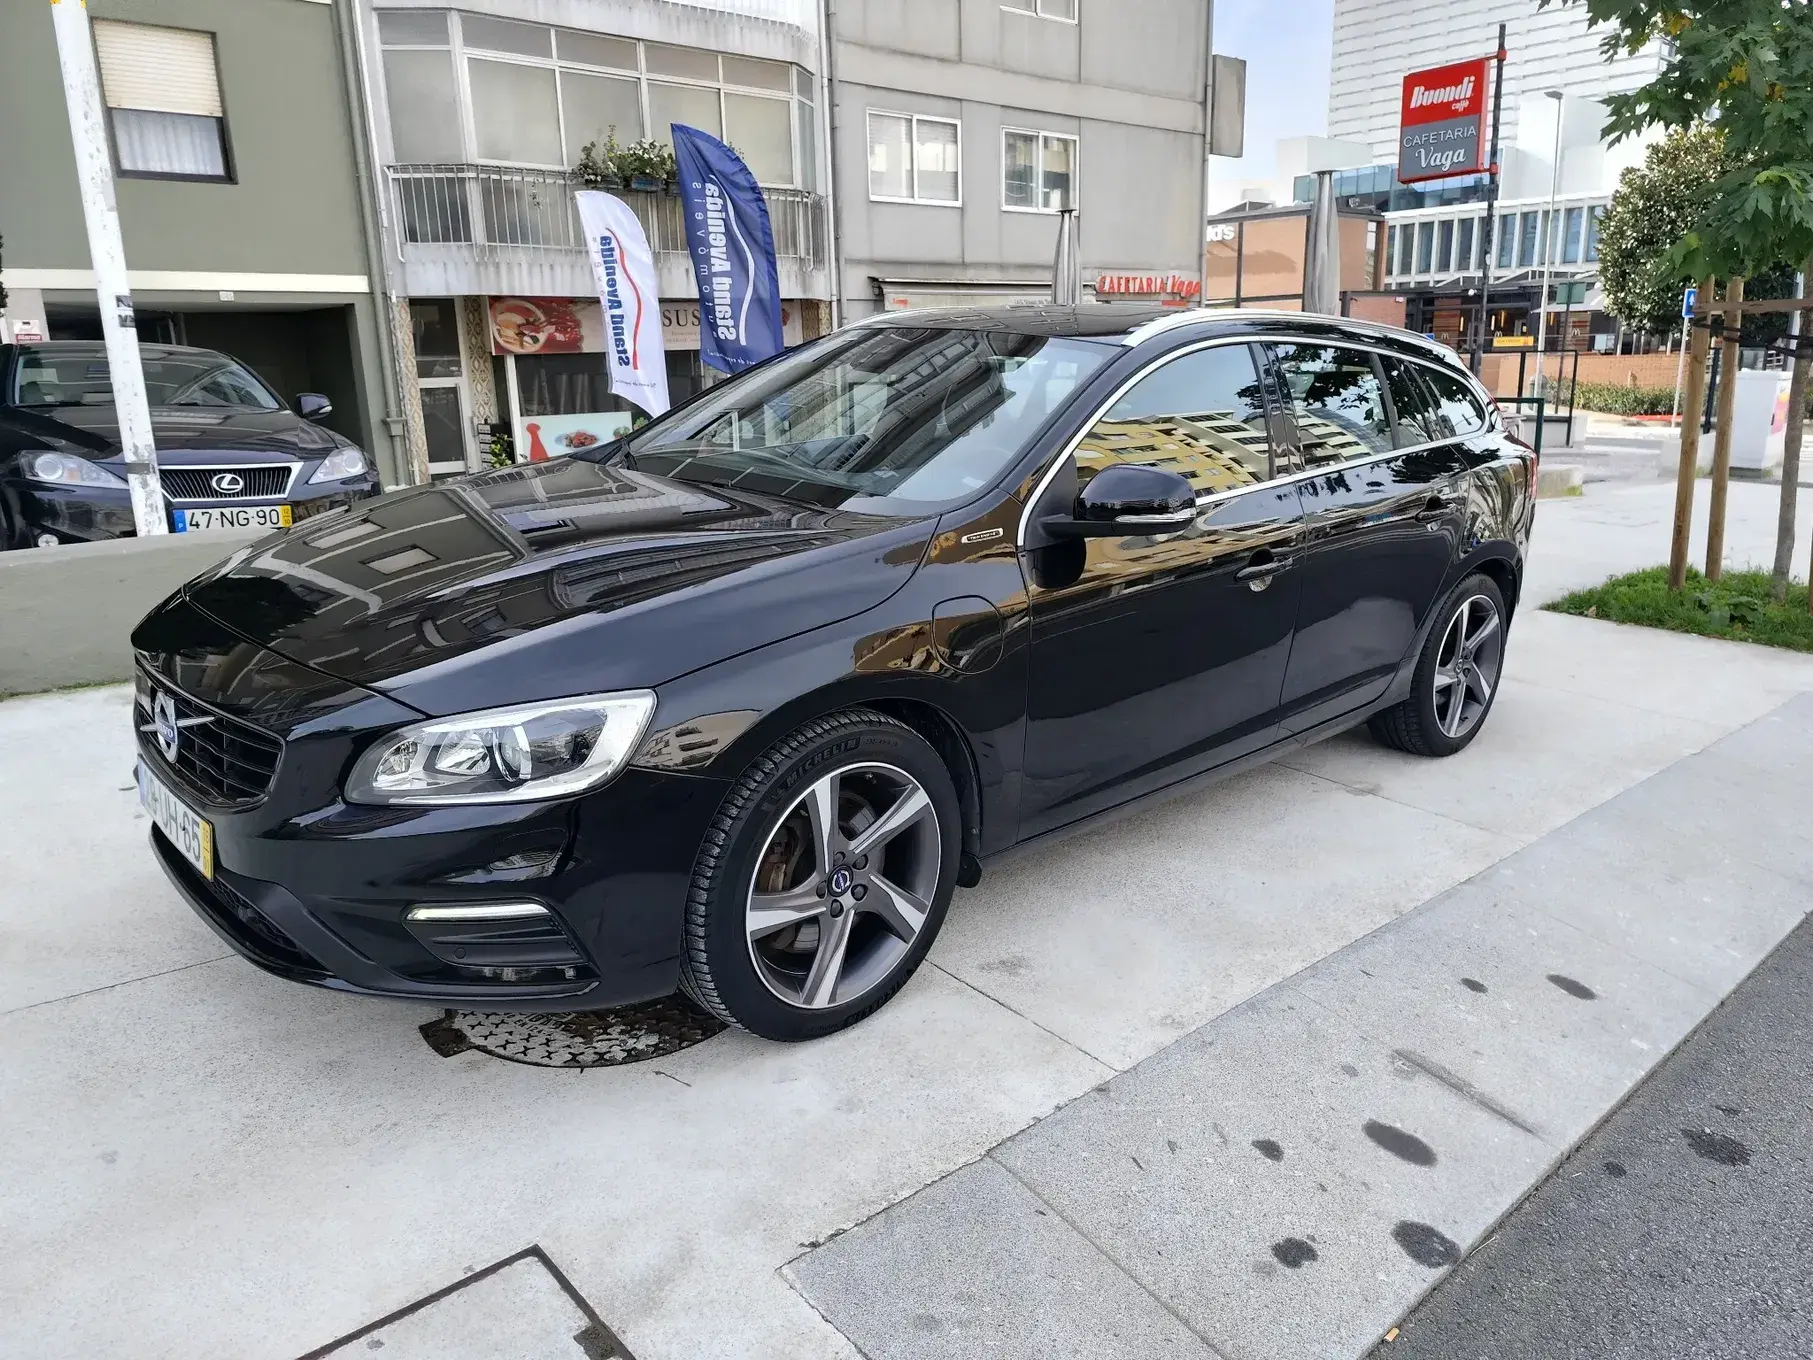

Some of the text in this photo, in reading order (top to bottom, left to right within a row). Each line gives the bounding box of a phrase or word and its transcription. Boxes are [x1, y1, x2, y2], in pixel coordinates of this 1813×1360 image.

[1410, 76, 1475, 109] Buondi
[1403, 126, 1477, 148] CAFETARIA
[1415, 146, 1466, 172] Vaga
[1097, 275, 1166, 294] CAFETARIA
[786, 740, 857, 787] MICHELIN
